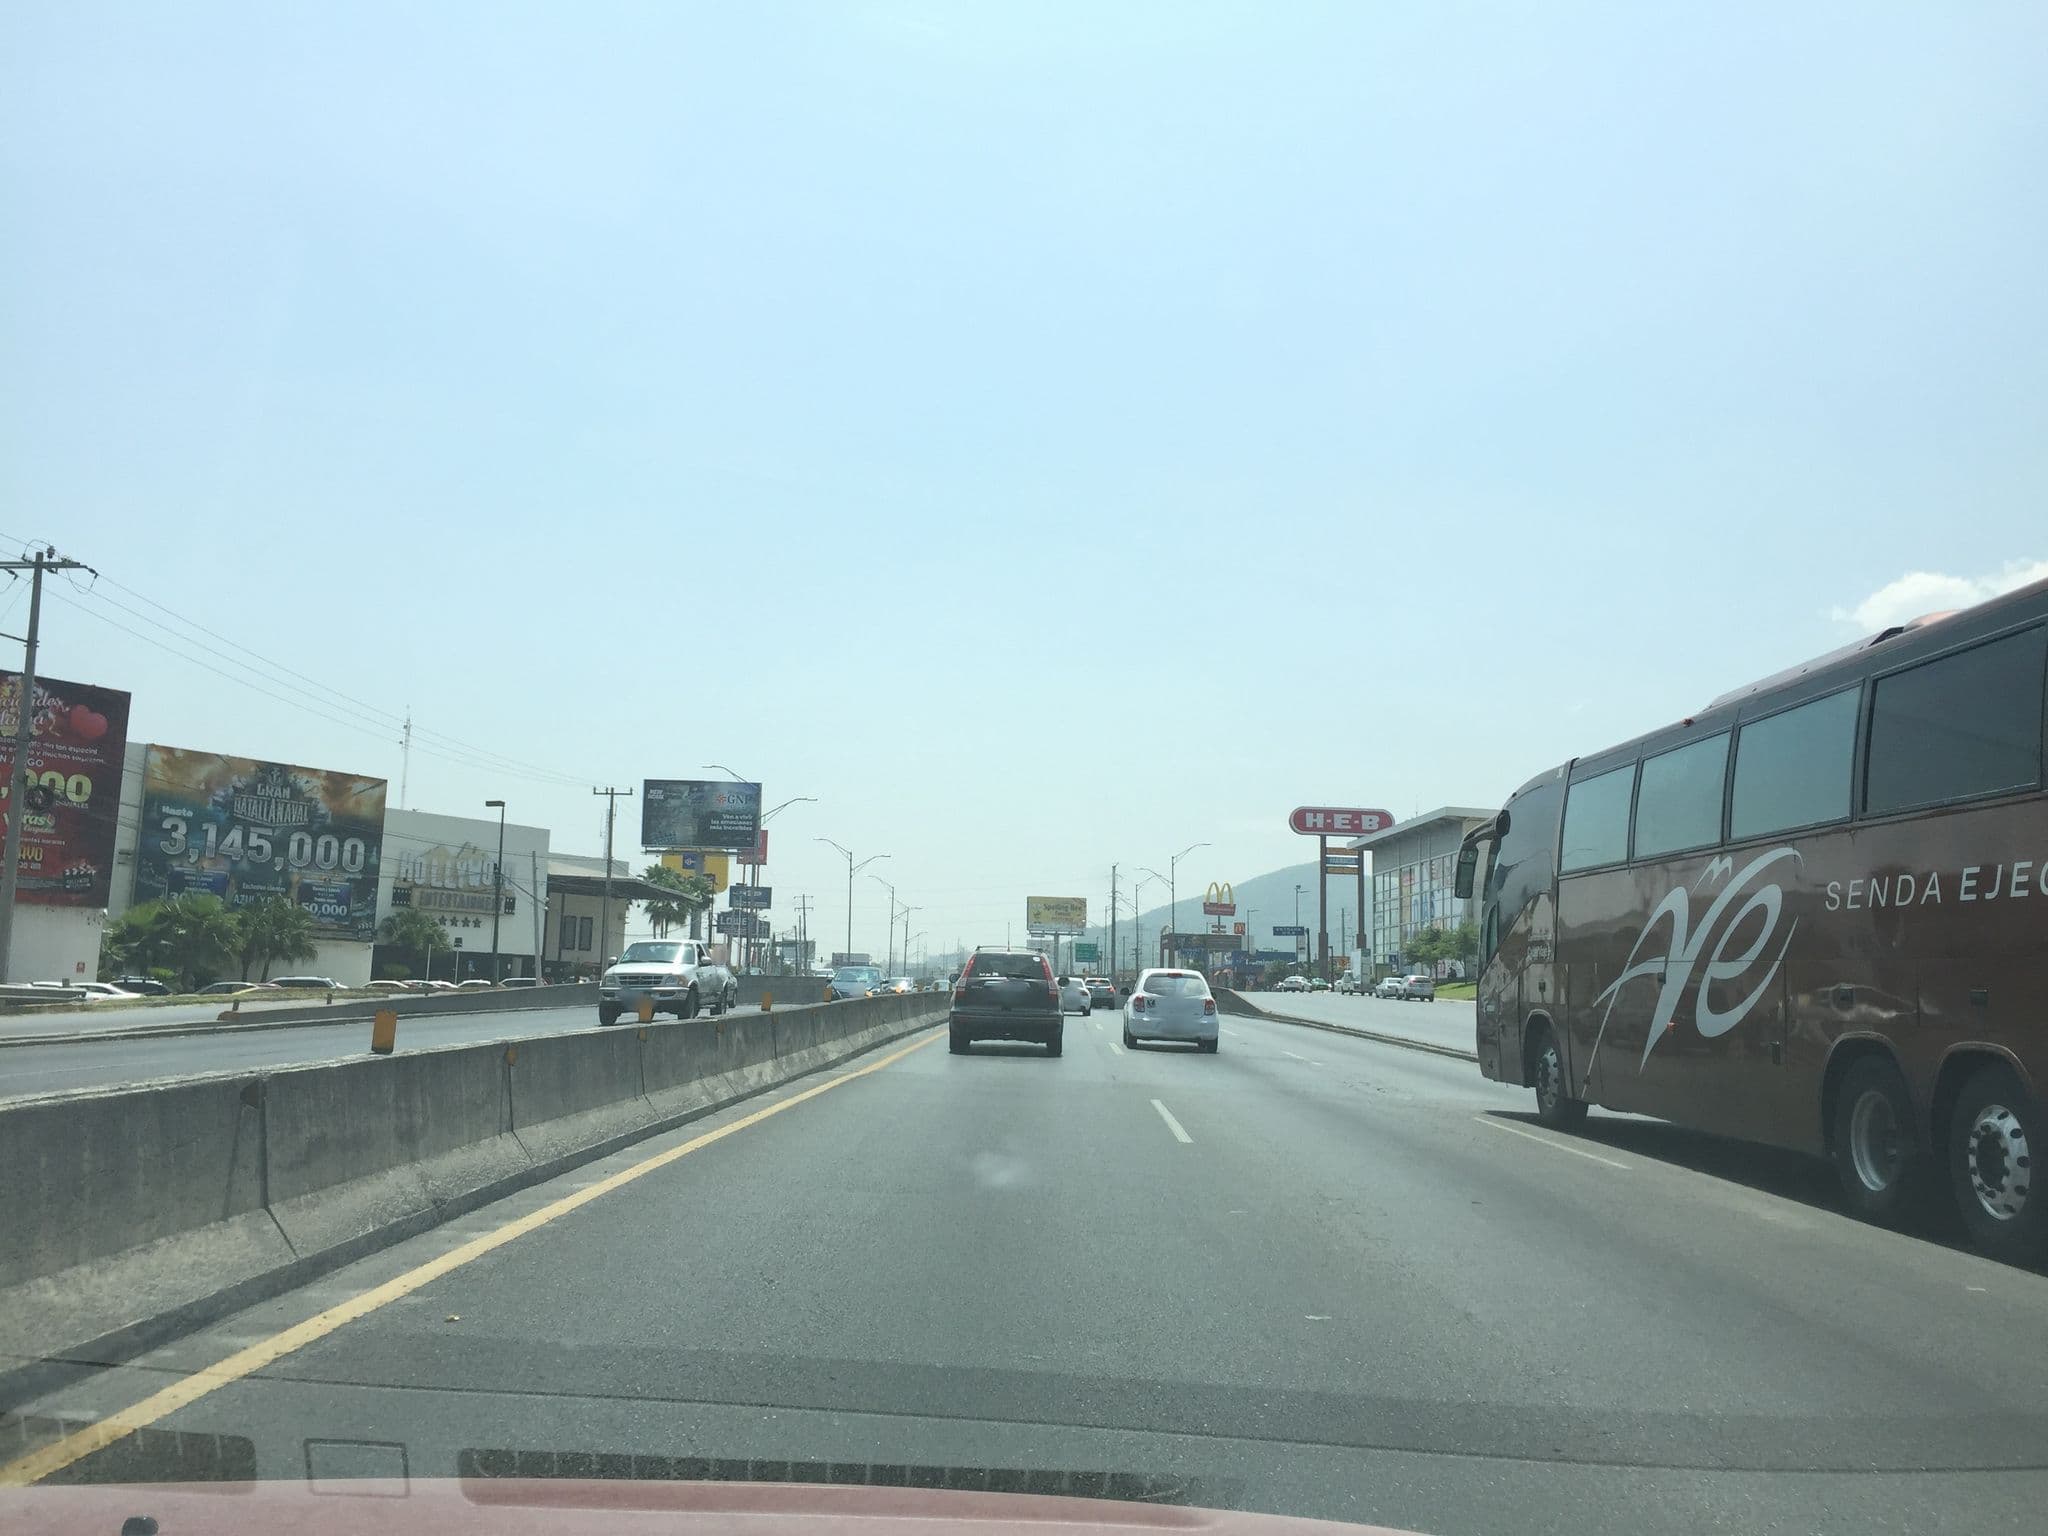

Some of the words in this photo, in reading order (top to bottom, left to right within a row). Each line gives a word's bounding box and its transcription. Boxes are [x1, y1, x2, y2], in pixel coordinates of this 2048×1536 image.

[257, 784, 291, 799] GRAN
[1305, 812, 1380, 830] H-E-B
[160, 816, 366, 872] 3,145,000
[1825, 872, 1942, 911] SENDA
